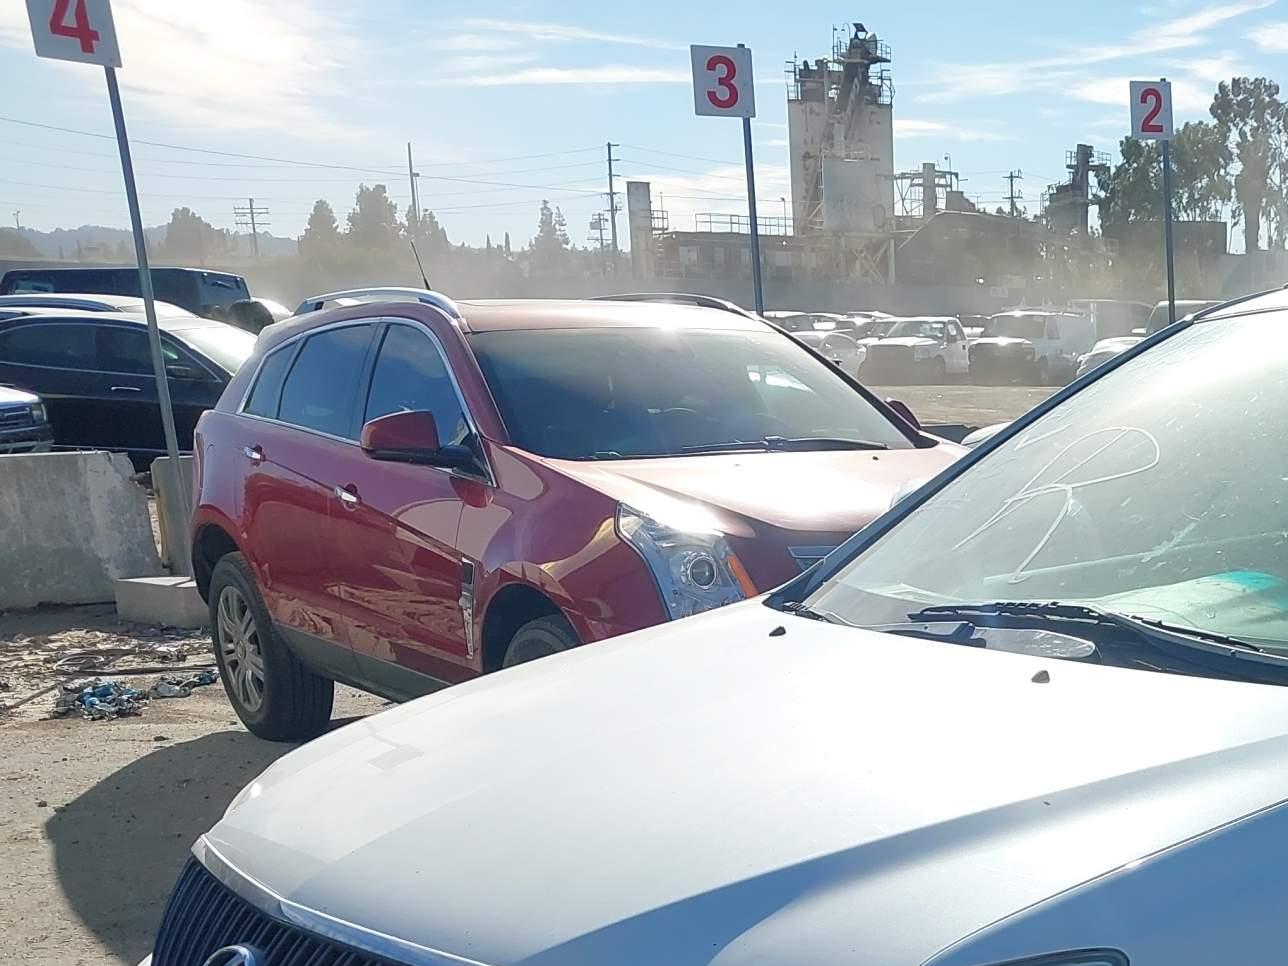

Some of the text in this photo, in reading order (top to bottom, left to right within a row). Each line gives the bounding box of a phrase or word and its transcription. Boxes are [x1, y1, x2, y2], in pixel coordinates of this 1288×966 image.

[49, 0, 99, 53] 4
[706, 56, 737, 108] 3
[1140, 88, 1163, 133] 2
